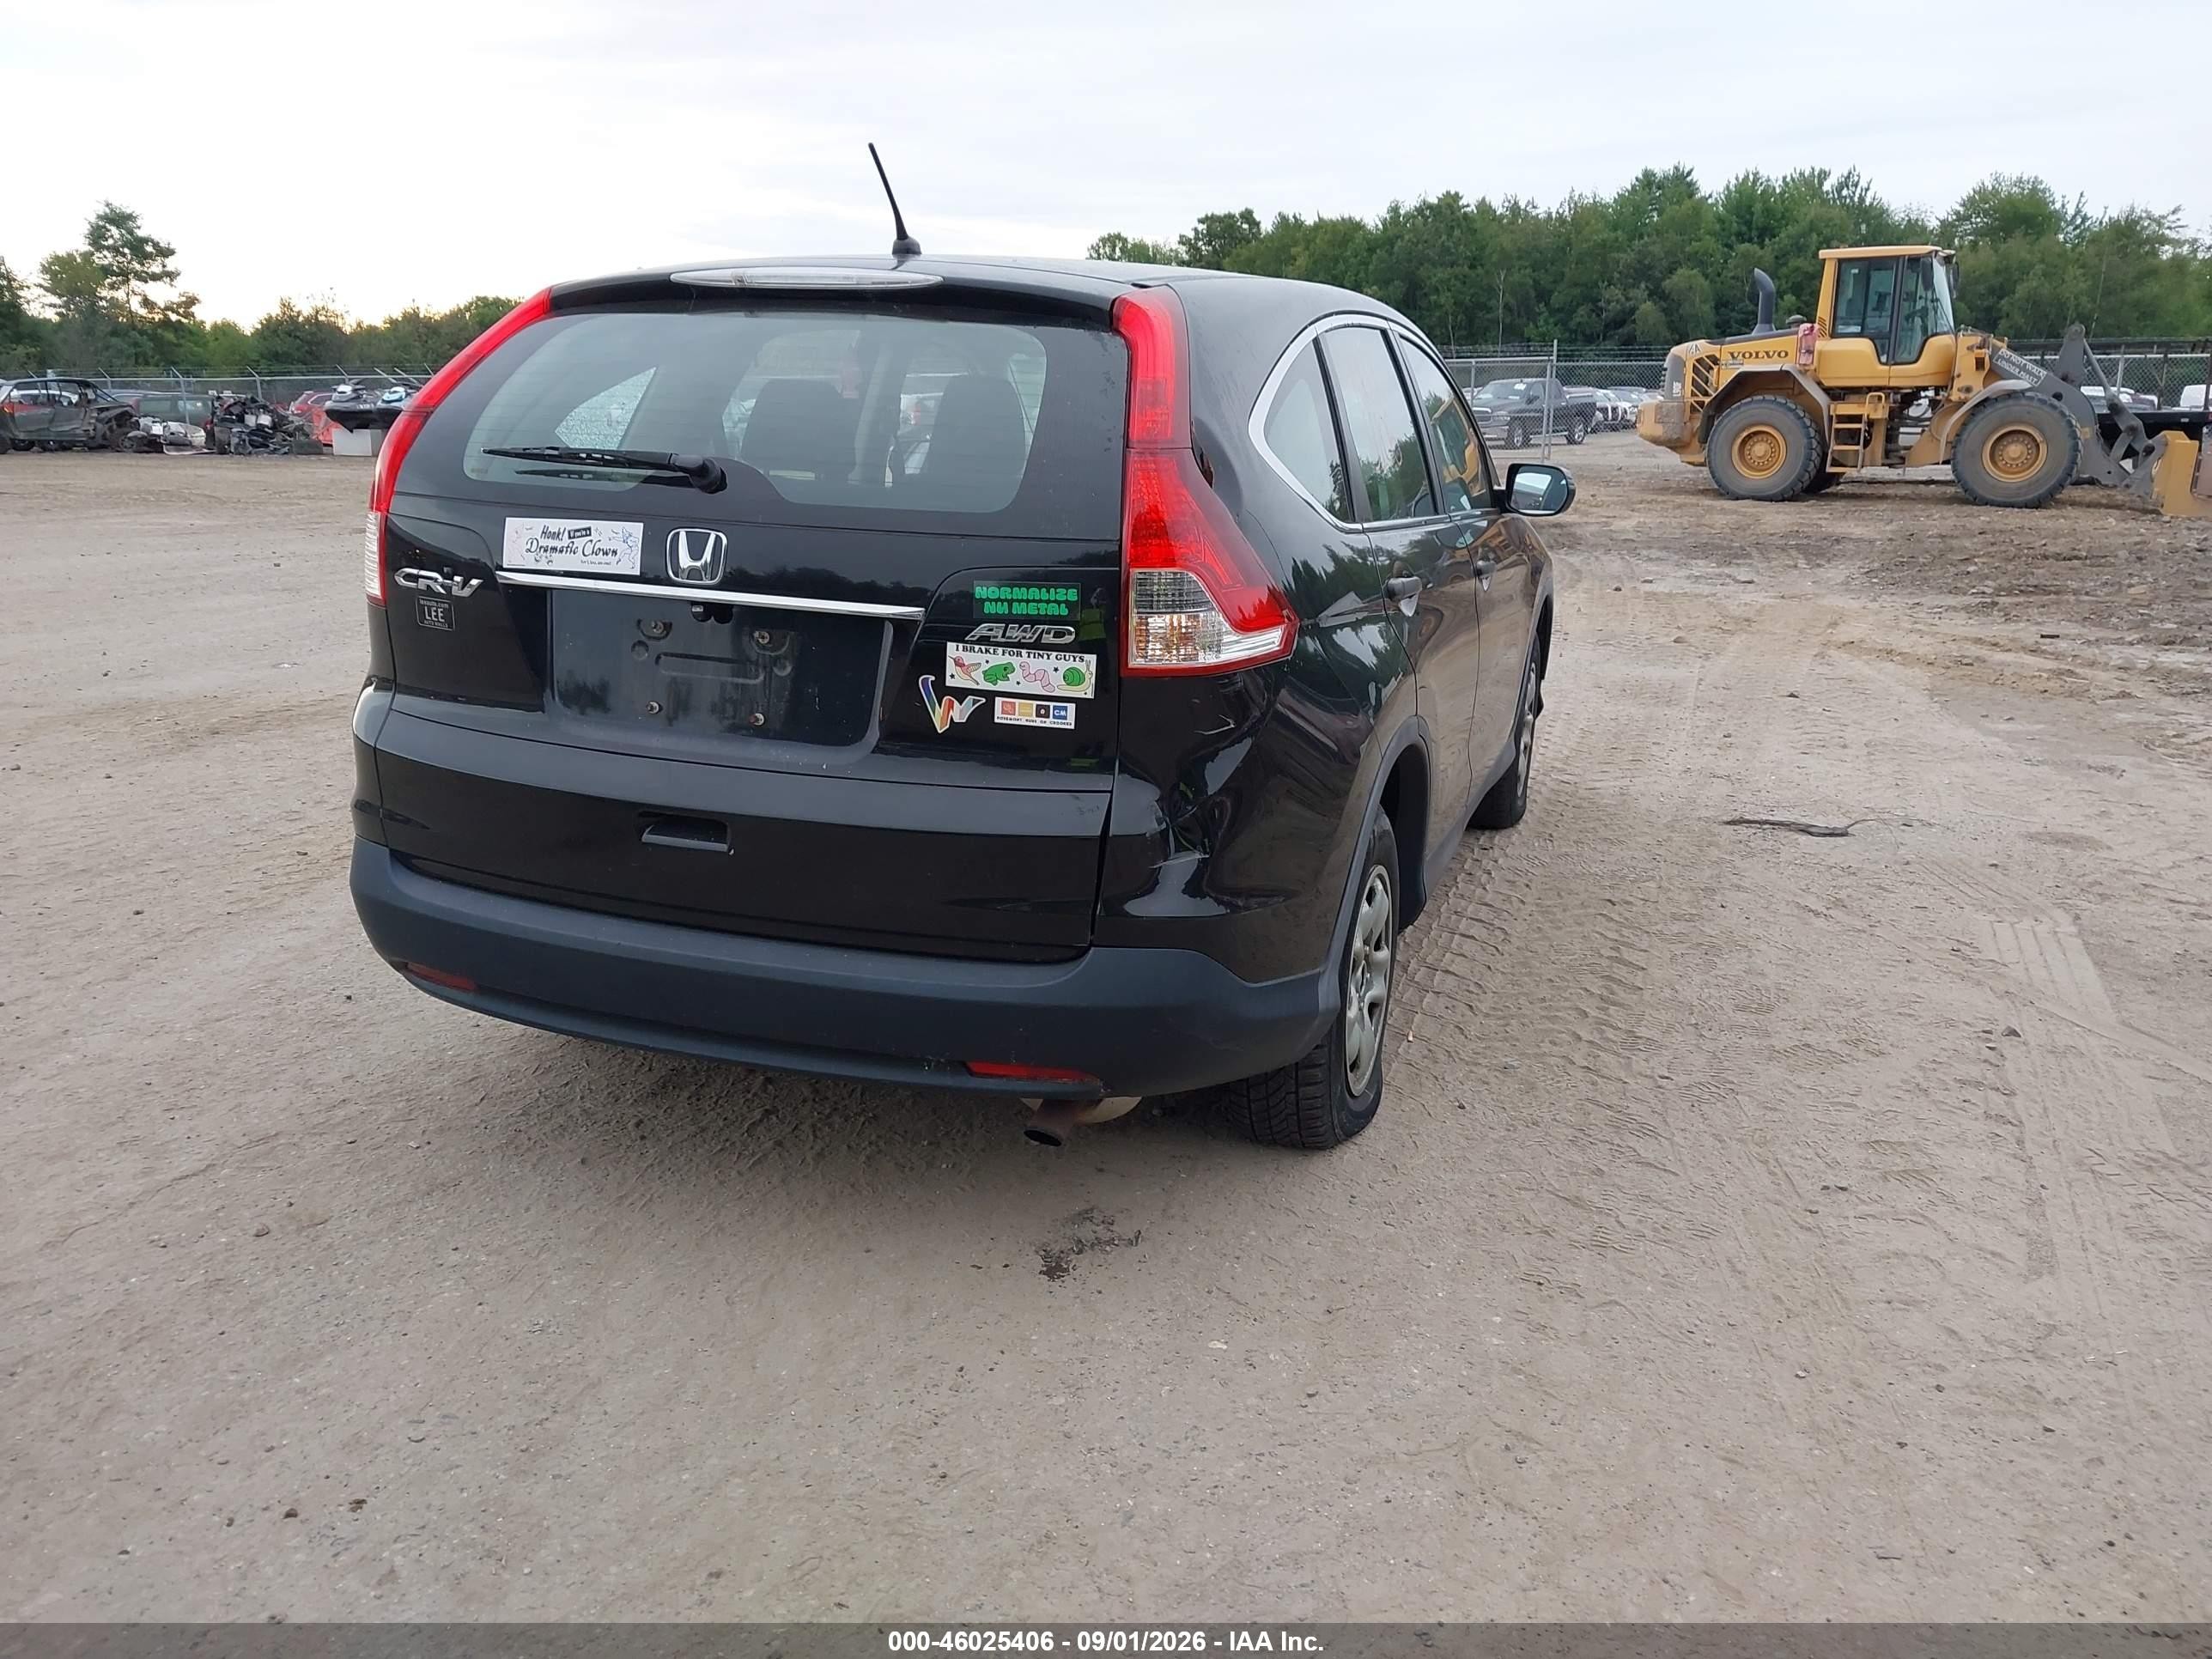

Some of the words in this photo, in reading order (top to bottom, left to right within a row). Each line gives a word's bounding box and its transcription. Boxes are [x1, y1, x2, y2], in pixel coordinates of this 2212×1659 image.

[1728, 350, 1789, 360] VOLVO
[1999, 349, 2009, 358] DO
[2009, 354, 2025, 367] NOT
[2027, 363, 2045, 378] WALK
[2020, 371, 2039, 385] MAST
[540, 525, 567, 541] Honk!
[525, 538, 579, 556] Dramatic
[582, 539, 618, 557] Clown
[975, 586, 1079, 601] NORMALIZE
[424, 605, 445, 622] LEE
[983, 601, 1009, 615] NU
[1012, 602, 1069, 616] METAL
[964, 623, 1076, 644] AWD
[962, 645, 1000, 656] BRAKE
[1001, 648, 1024, 658] FOR
[1025, 651, 1053, 660] TINY
[1054, 653, 1085, 663] GUYS
